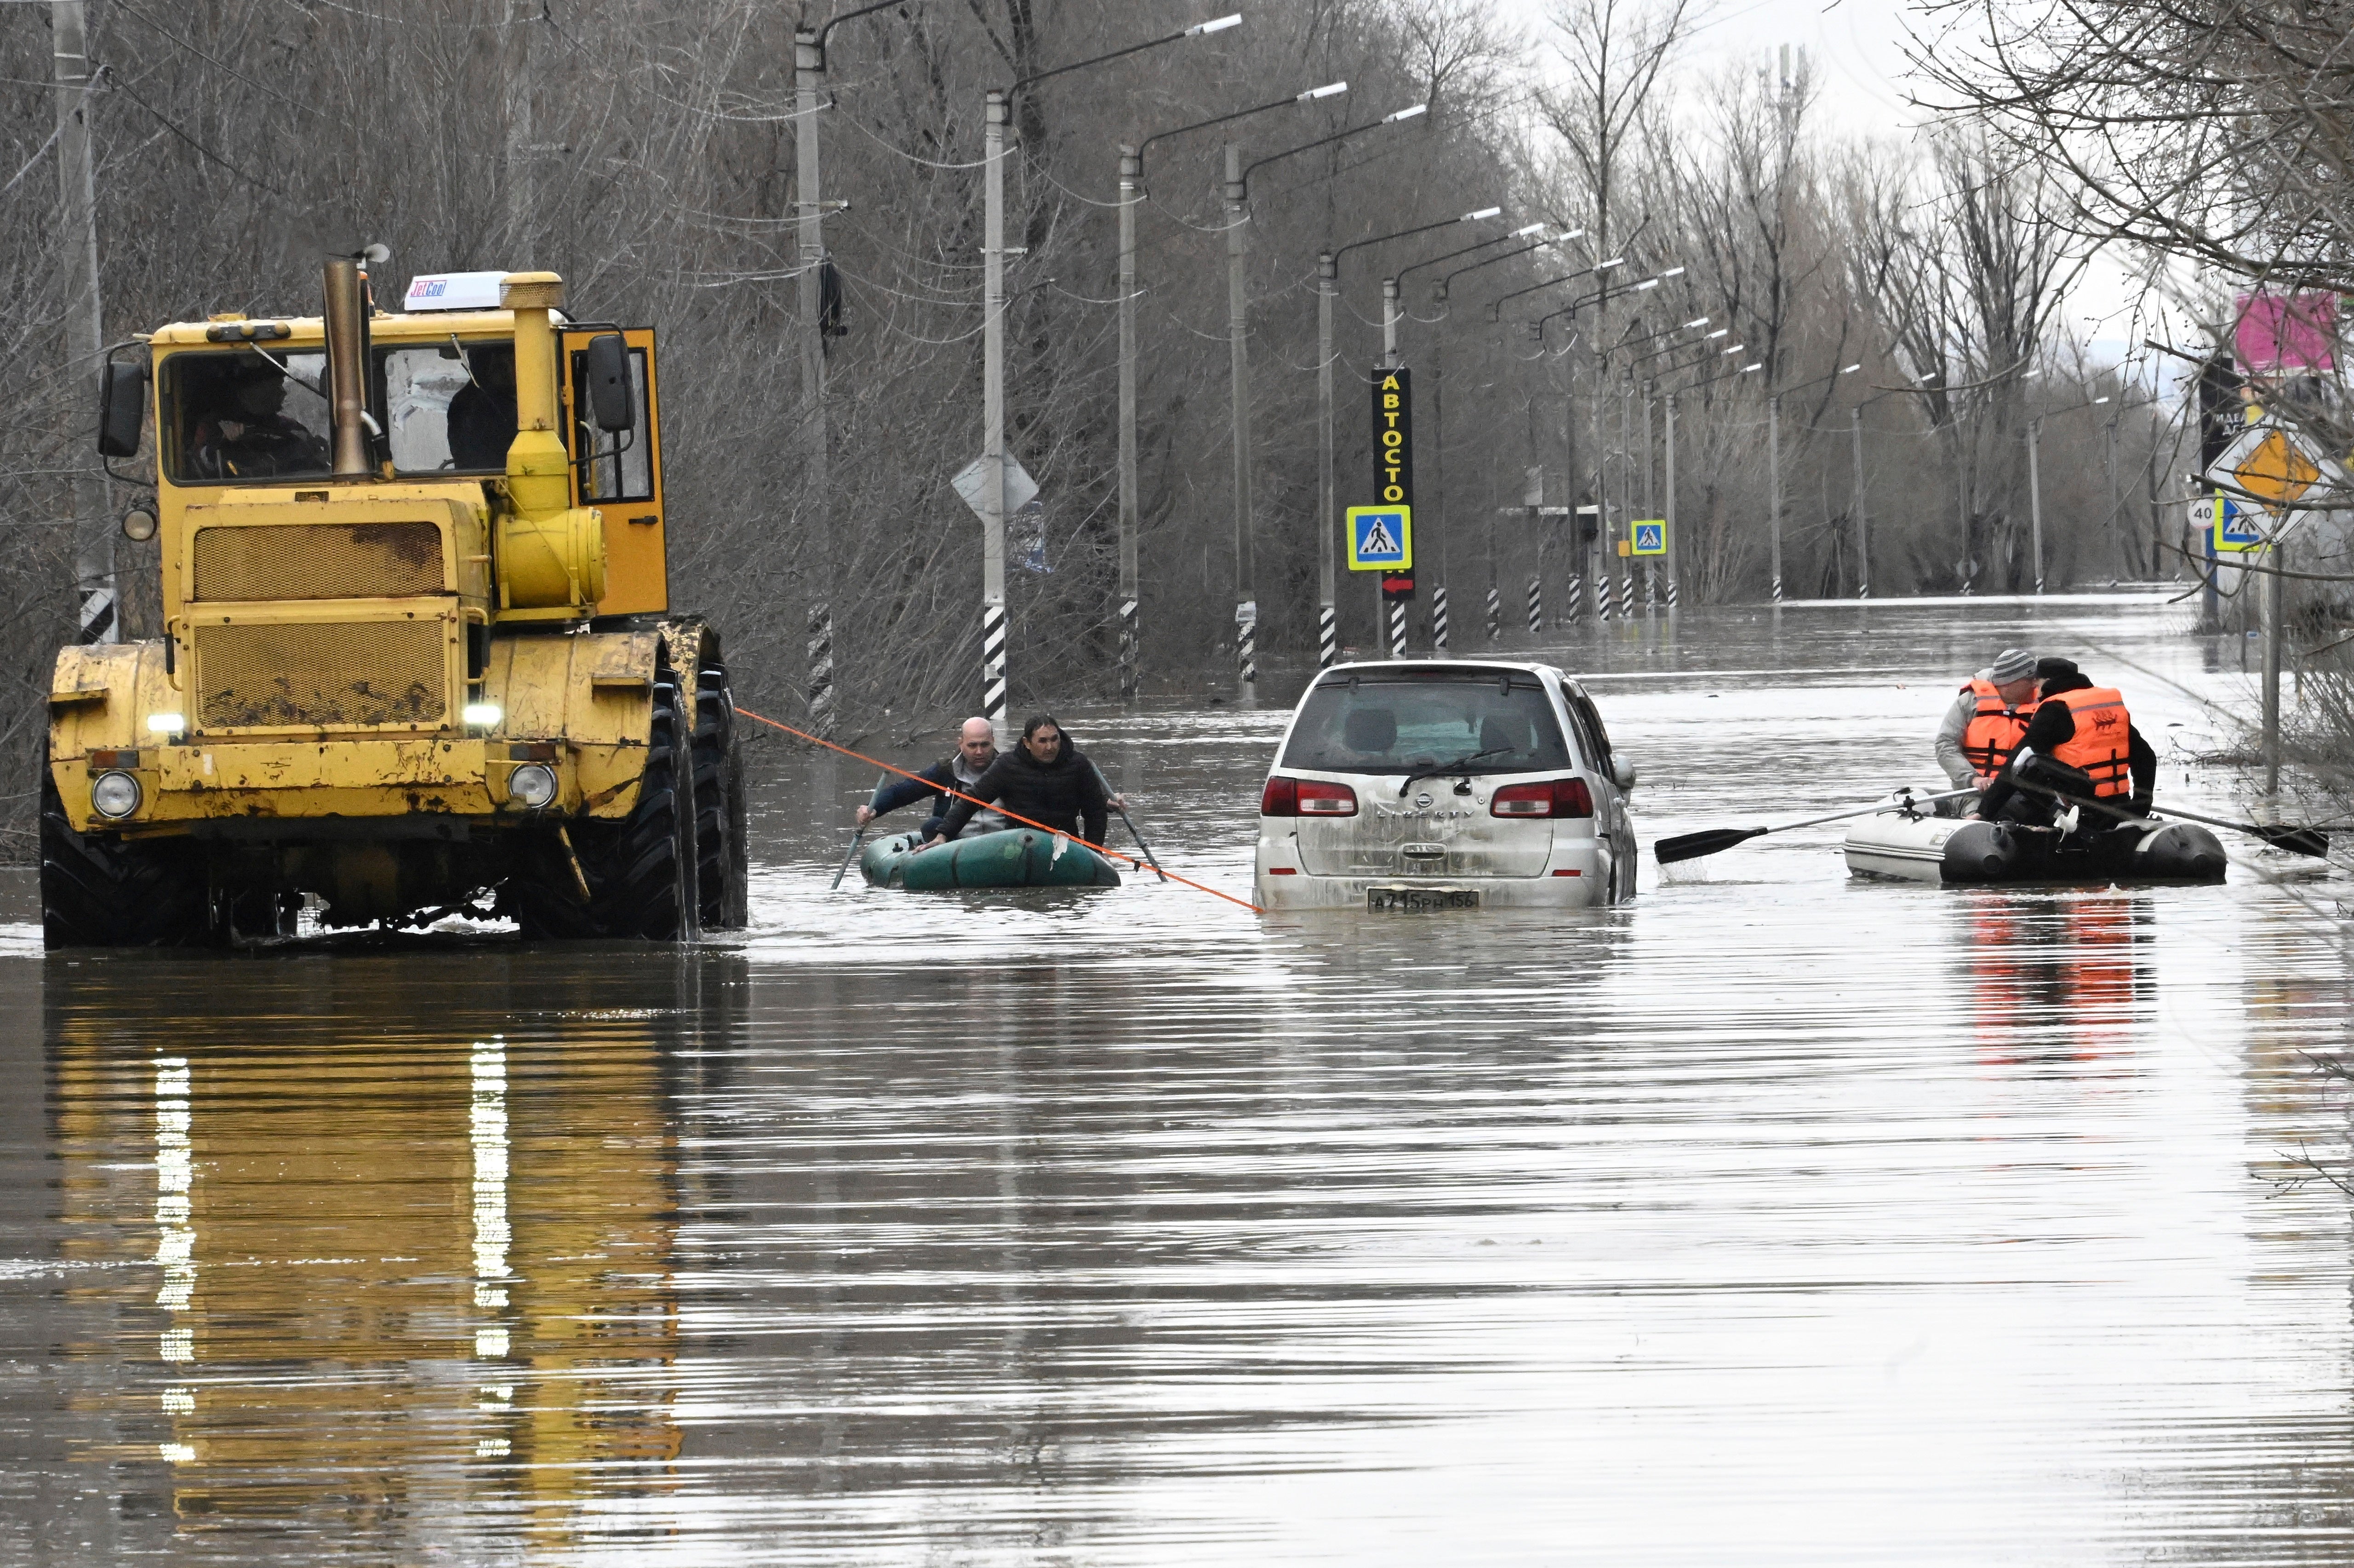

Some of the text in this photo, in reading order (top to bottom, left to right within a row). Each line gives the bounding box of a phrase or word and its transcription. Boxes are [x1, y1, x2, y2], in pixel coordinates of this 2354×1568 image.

[410, 281, 447, 296] JetCool
[1382, 375, 1404, 573] АВТОСТО
[2194, 507, 2212, 519] 40
